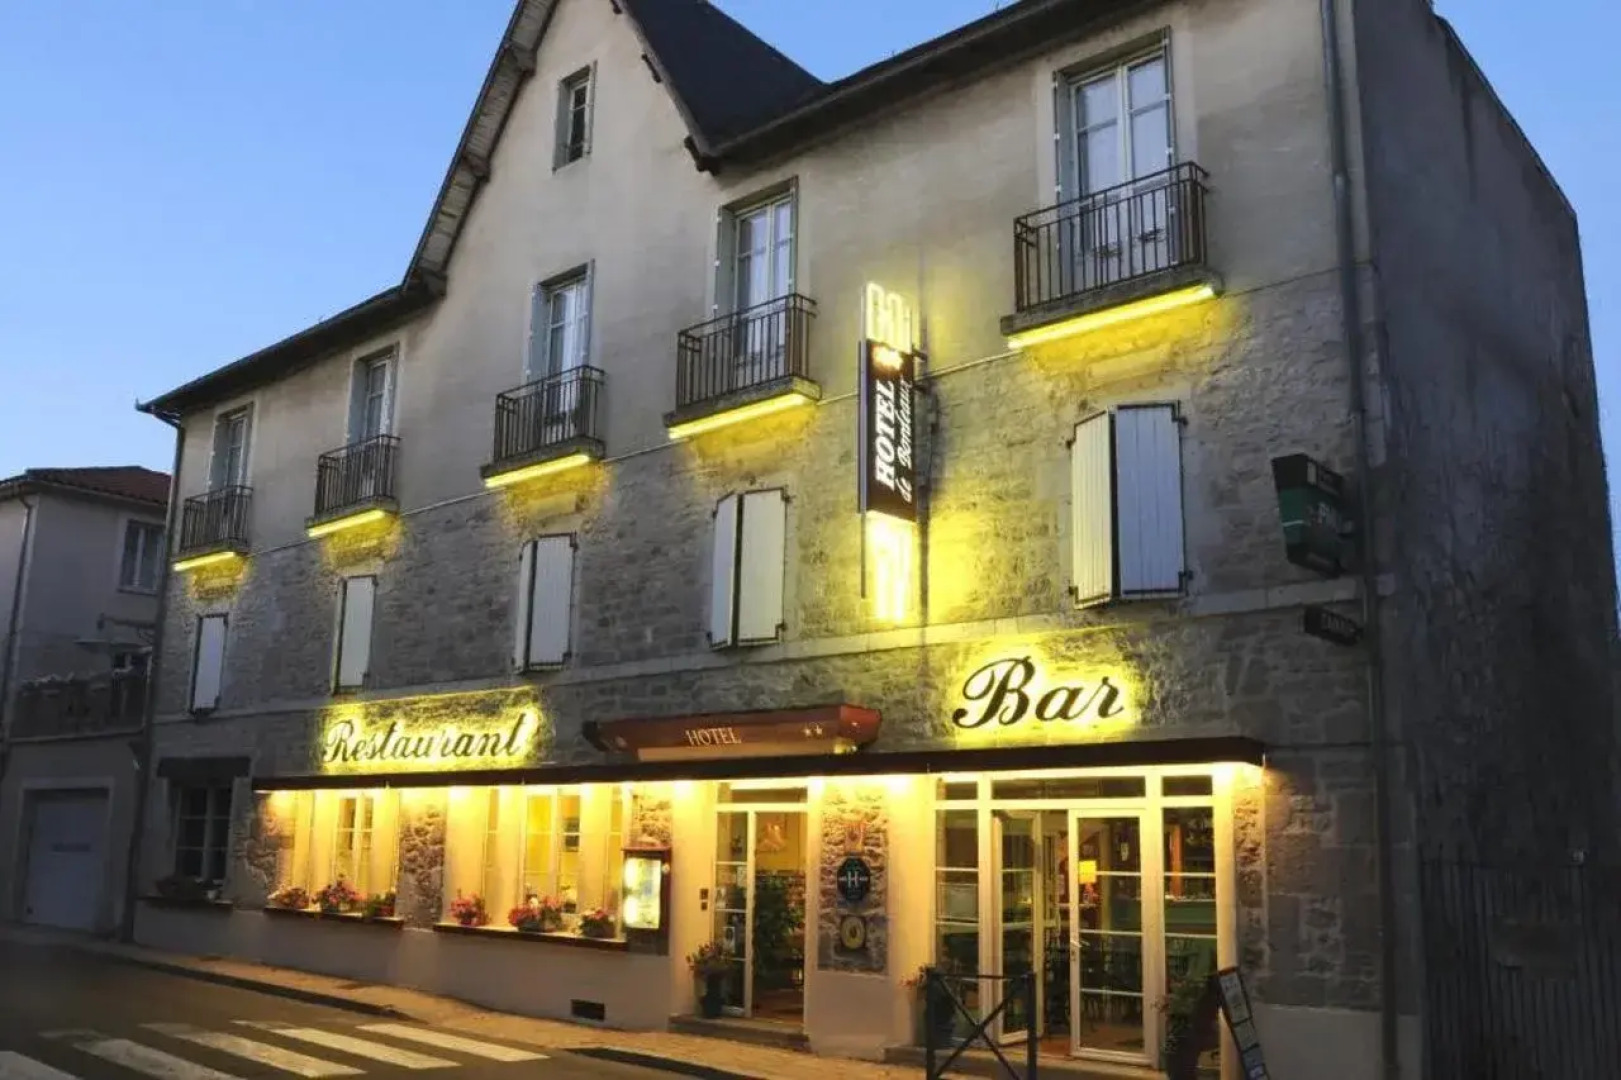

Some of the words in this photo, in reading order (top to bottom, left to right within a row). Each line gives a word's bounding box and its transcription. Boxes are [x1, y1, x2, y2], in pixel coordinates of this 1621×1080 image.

[875, 379, 895, 491] HOTEL
[894, 476, 912, 503] de
[952, 655, 1124, 728] Bar
[320, 712, 527, 763] Restaurant
[685, 727, 742, 746] HOTEL
